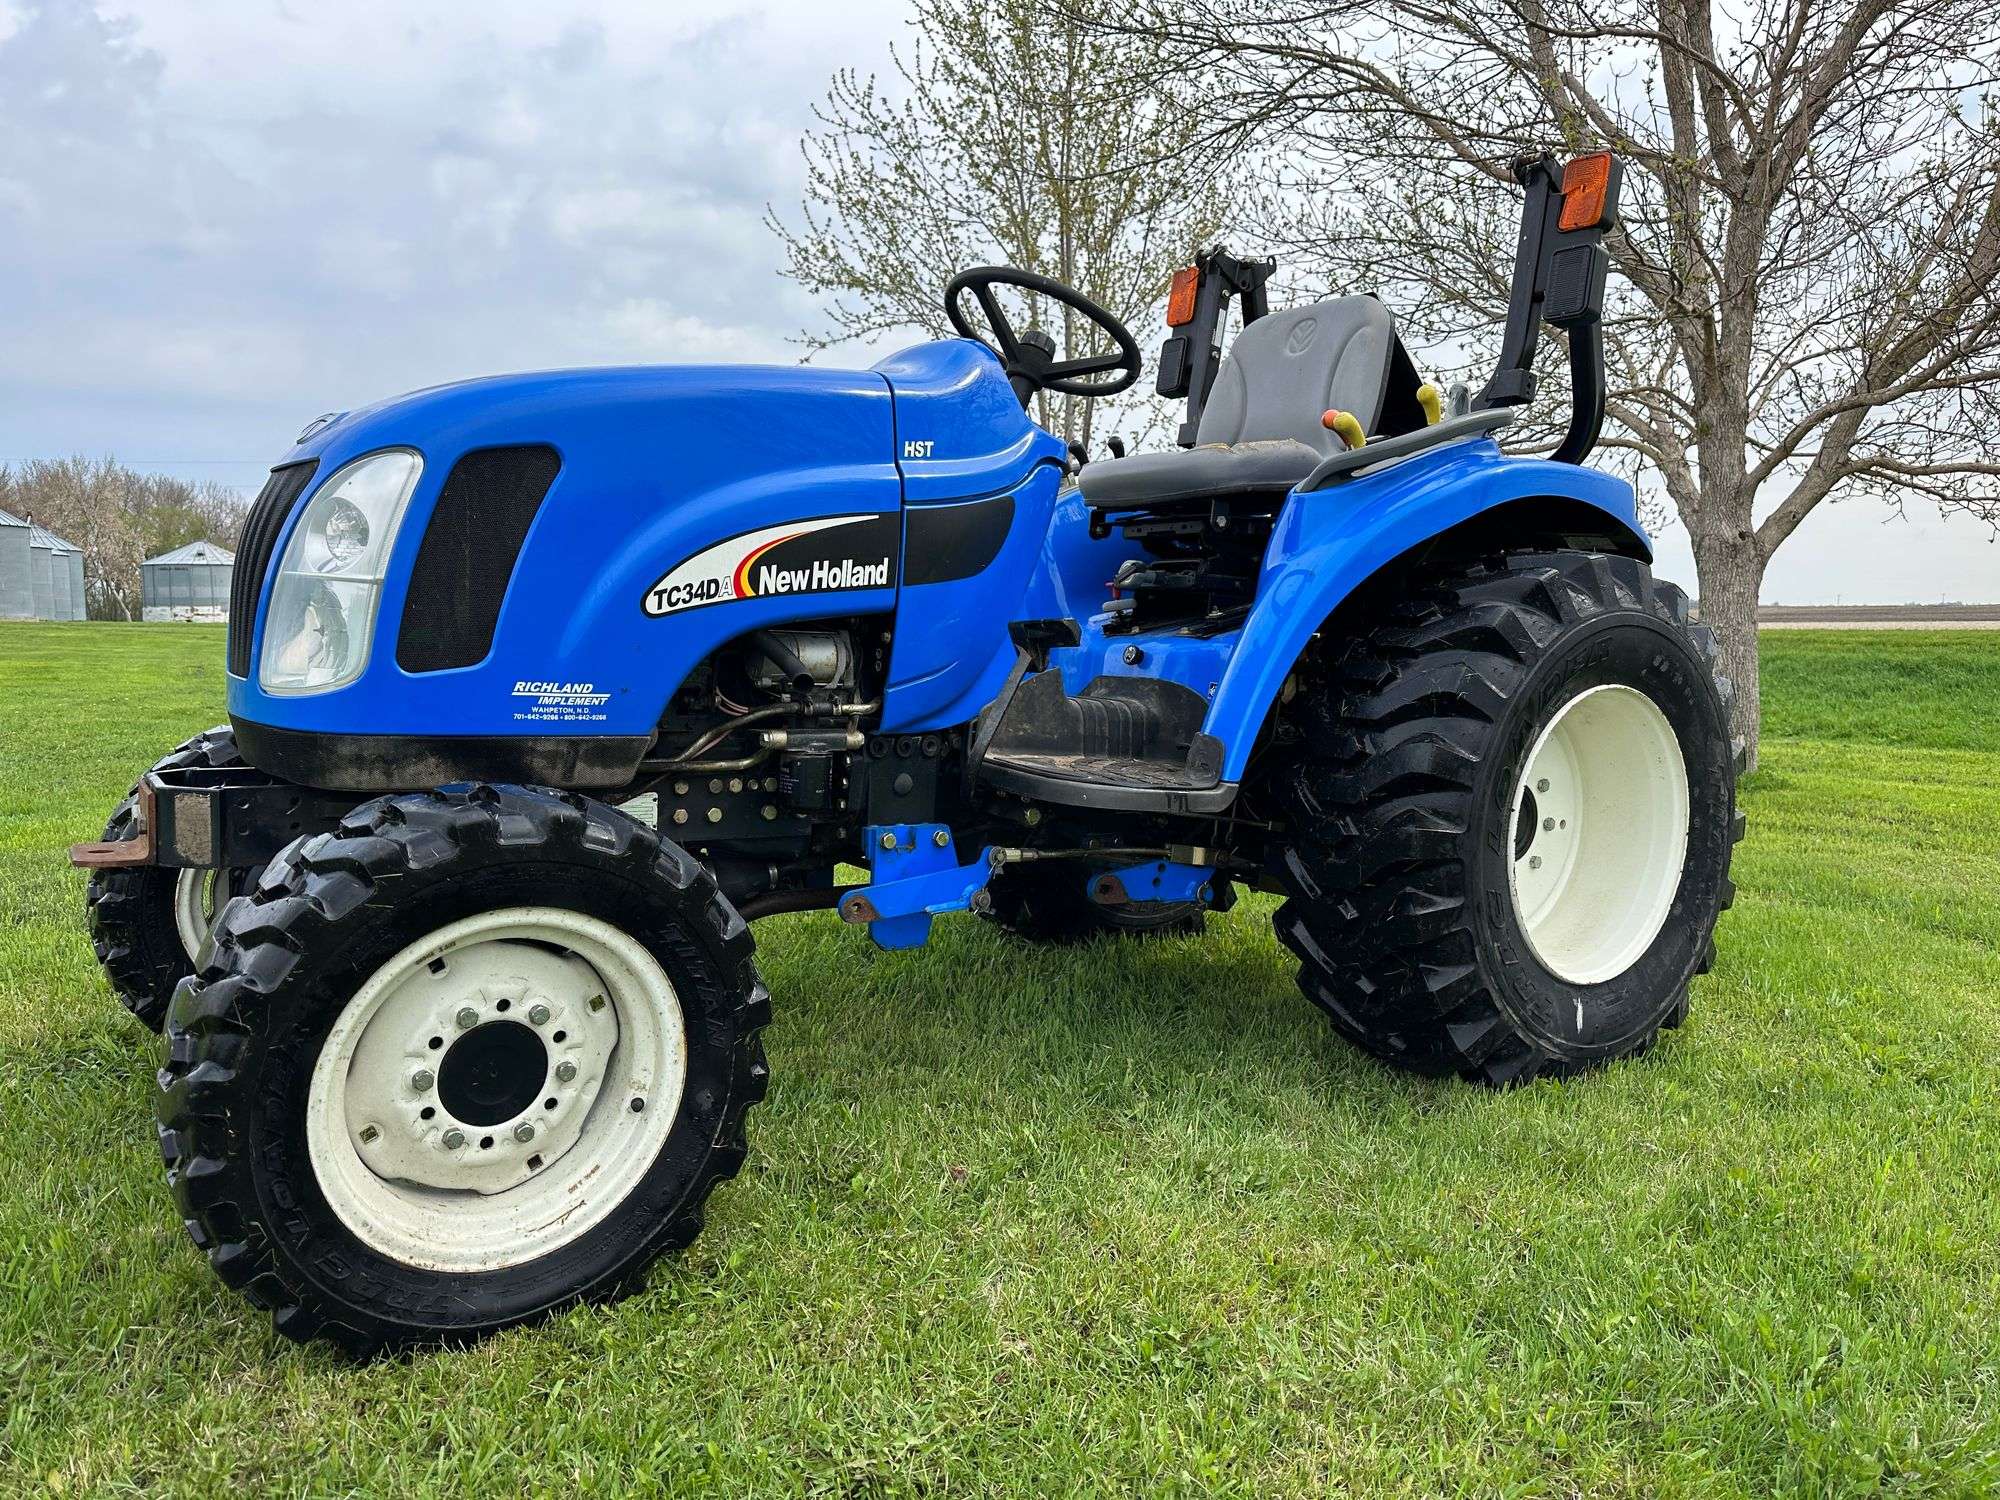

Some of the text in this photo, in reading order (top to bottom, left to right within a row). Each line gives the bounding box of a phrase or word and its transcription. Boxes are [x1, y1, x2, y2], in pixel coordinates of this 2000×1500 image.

[904, 440, 934, 457] HST
[758, 557, 889, 595] New Holland
[653, 576, 733, 610] TC34DA
[513, 681, 593, 693] RICHLAND
[537, 697, 608, 706] IMPLEMENT
[531, 706, 575, 714] WAHPETON,
